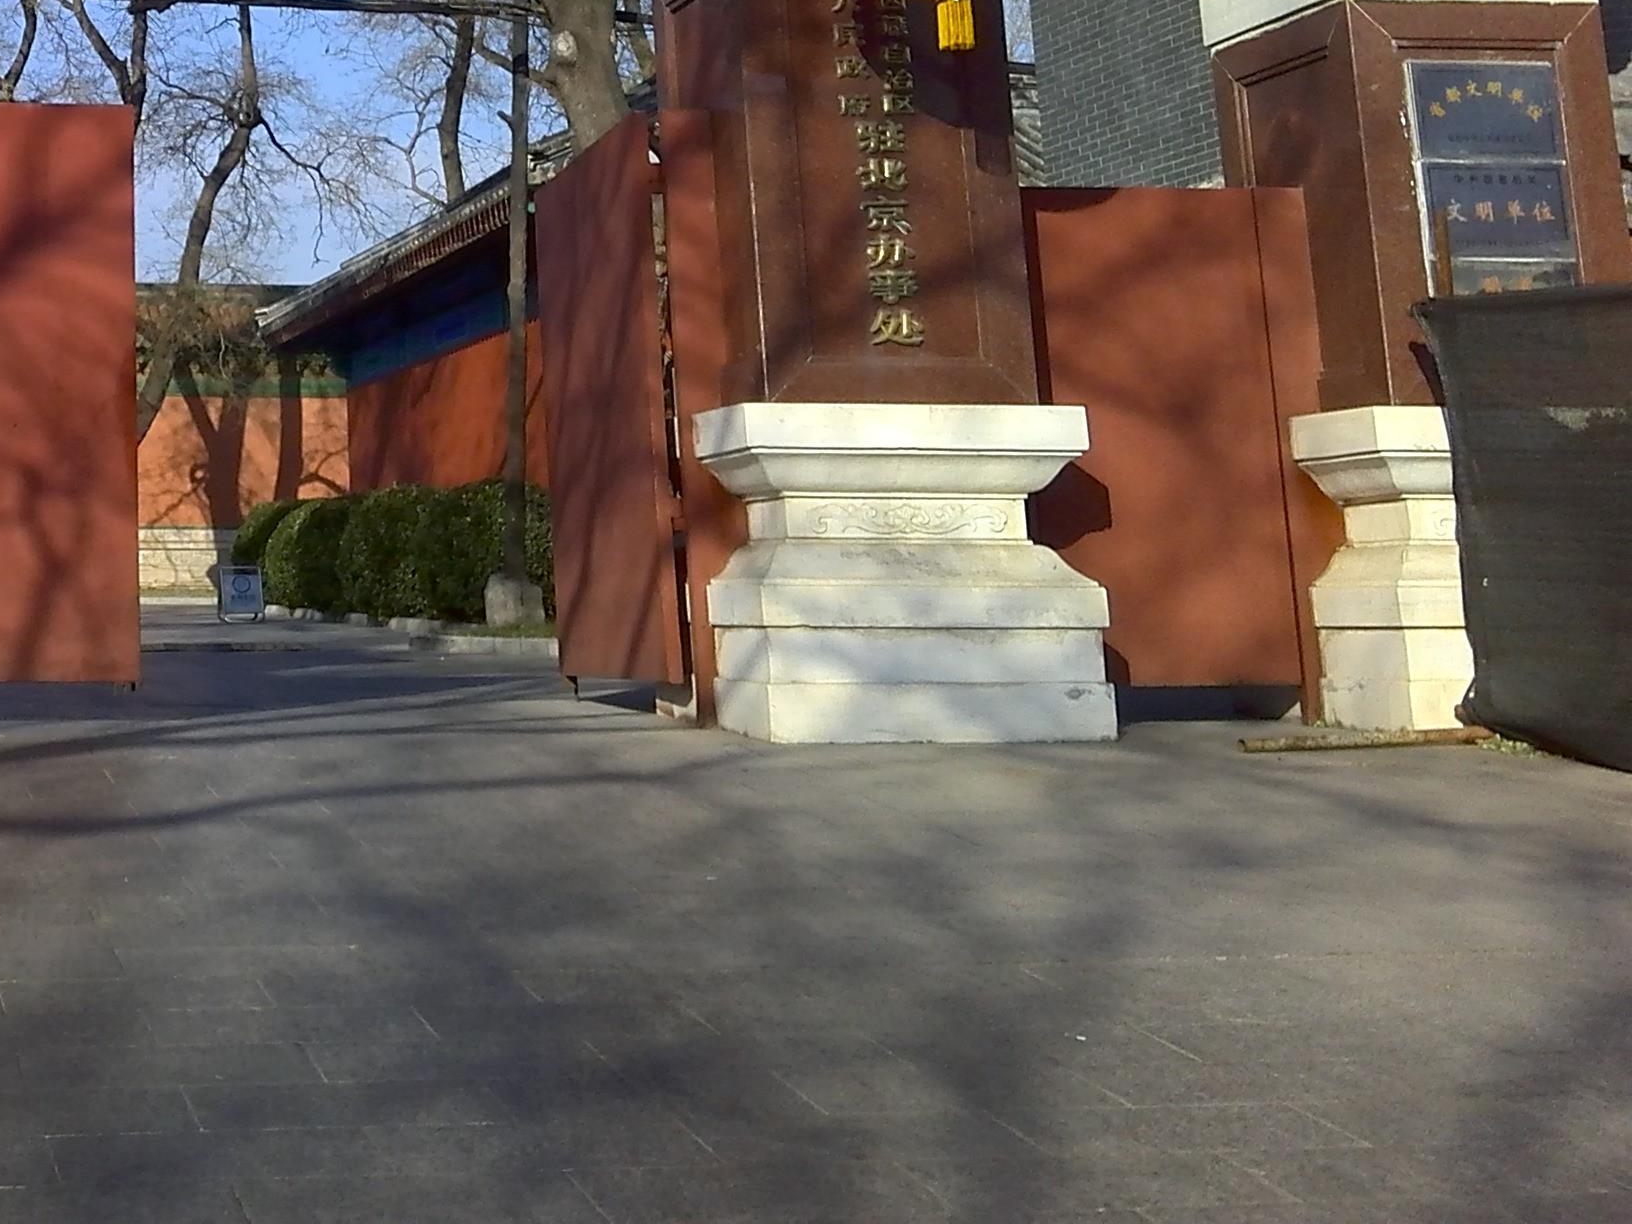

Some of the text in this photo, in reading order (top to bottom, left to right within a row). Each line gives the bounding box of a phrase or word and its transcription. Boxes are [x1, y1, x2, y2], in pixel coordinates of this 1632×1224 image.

[855, 120, 924, 347] 驻北京办事处
